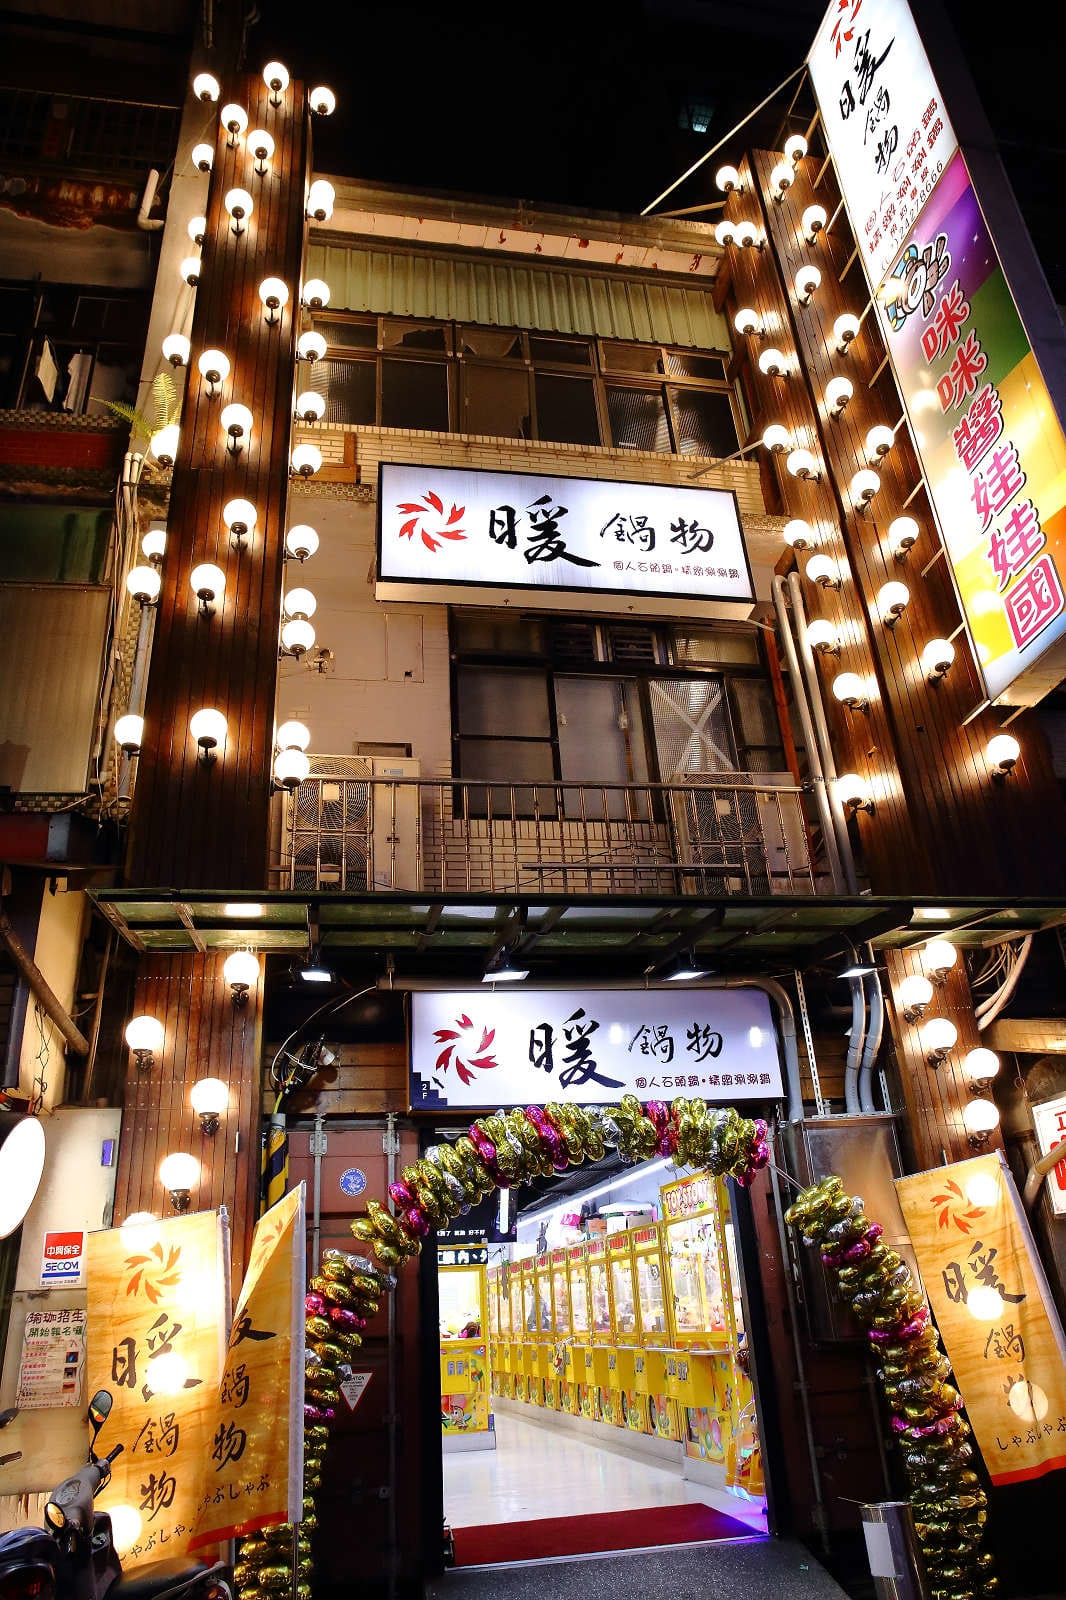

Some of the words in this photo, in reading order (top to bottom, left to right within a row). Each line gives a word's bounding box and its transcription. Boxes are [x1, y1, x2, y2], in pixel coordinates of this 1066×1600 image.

[46, 1245, 80, 1256] 中興保全
[45, 1261, 79, 1271] SECOM
[27, 1309, 84, 1325] 瑜珈招生
